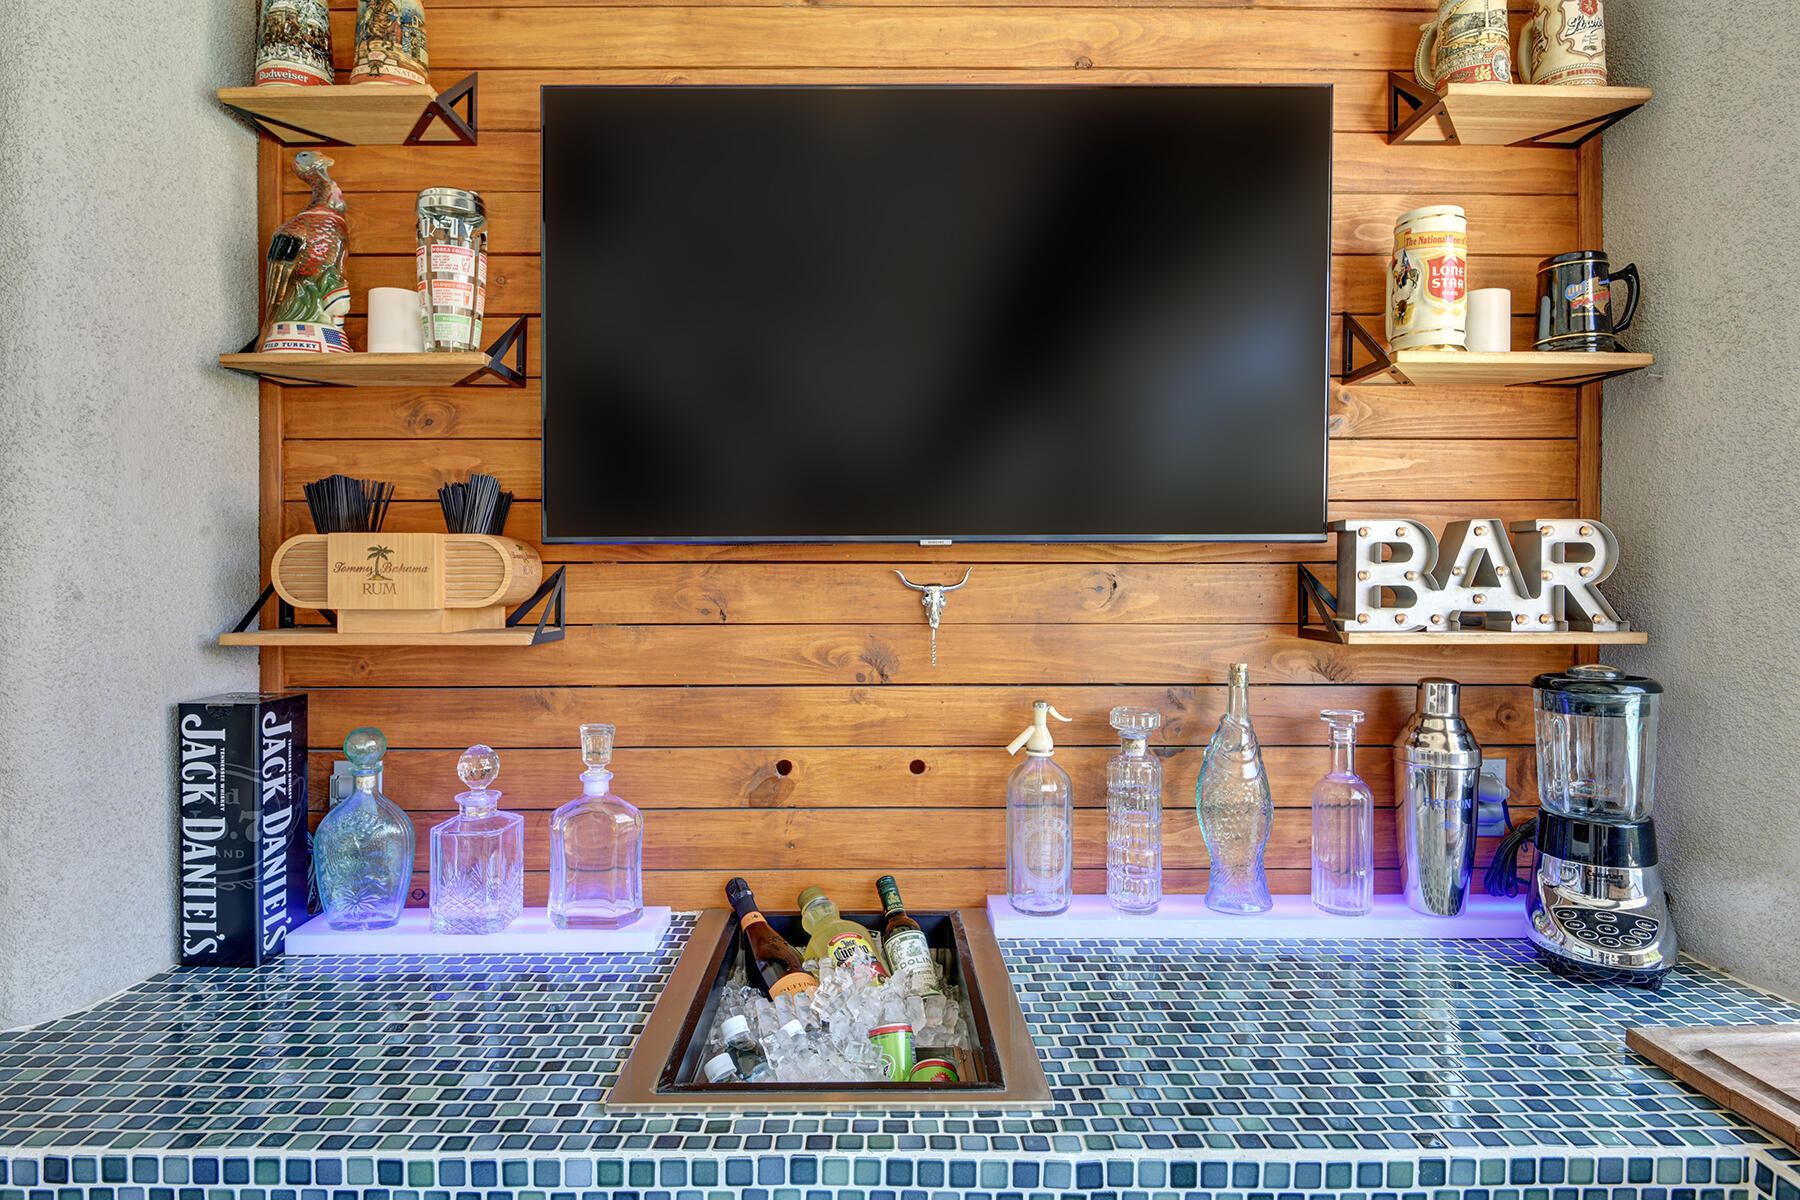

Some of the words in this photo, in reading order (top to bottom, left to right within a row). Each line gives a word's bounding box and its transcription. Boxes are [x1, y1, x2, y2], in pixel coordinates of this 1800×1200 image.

[259, 69, 309, 83] Budweiser
[1405, 237, 1417, 246] The
[1418, 235, 1448, 245] National
[1432, 265, 1464, 278] LONE
[1431, 278, 1464, 290] STAR
[333, 561, 373, 577] Tommy
[380, 561, 430, 574] Bahama
[1342, 518, 1632, 633] BAR
[361, 582, 398, 595] RUM
[181, 713, 226, 807] JACK
[262, 711, 292, 805] JACK
[900, 957, 932, 970] DOLIN
